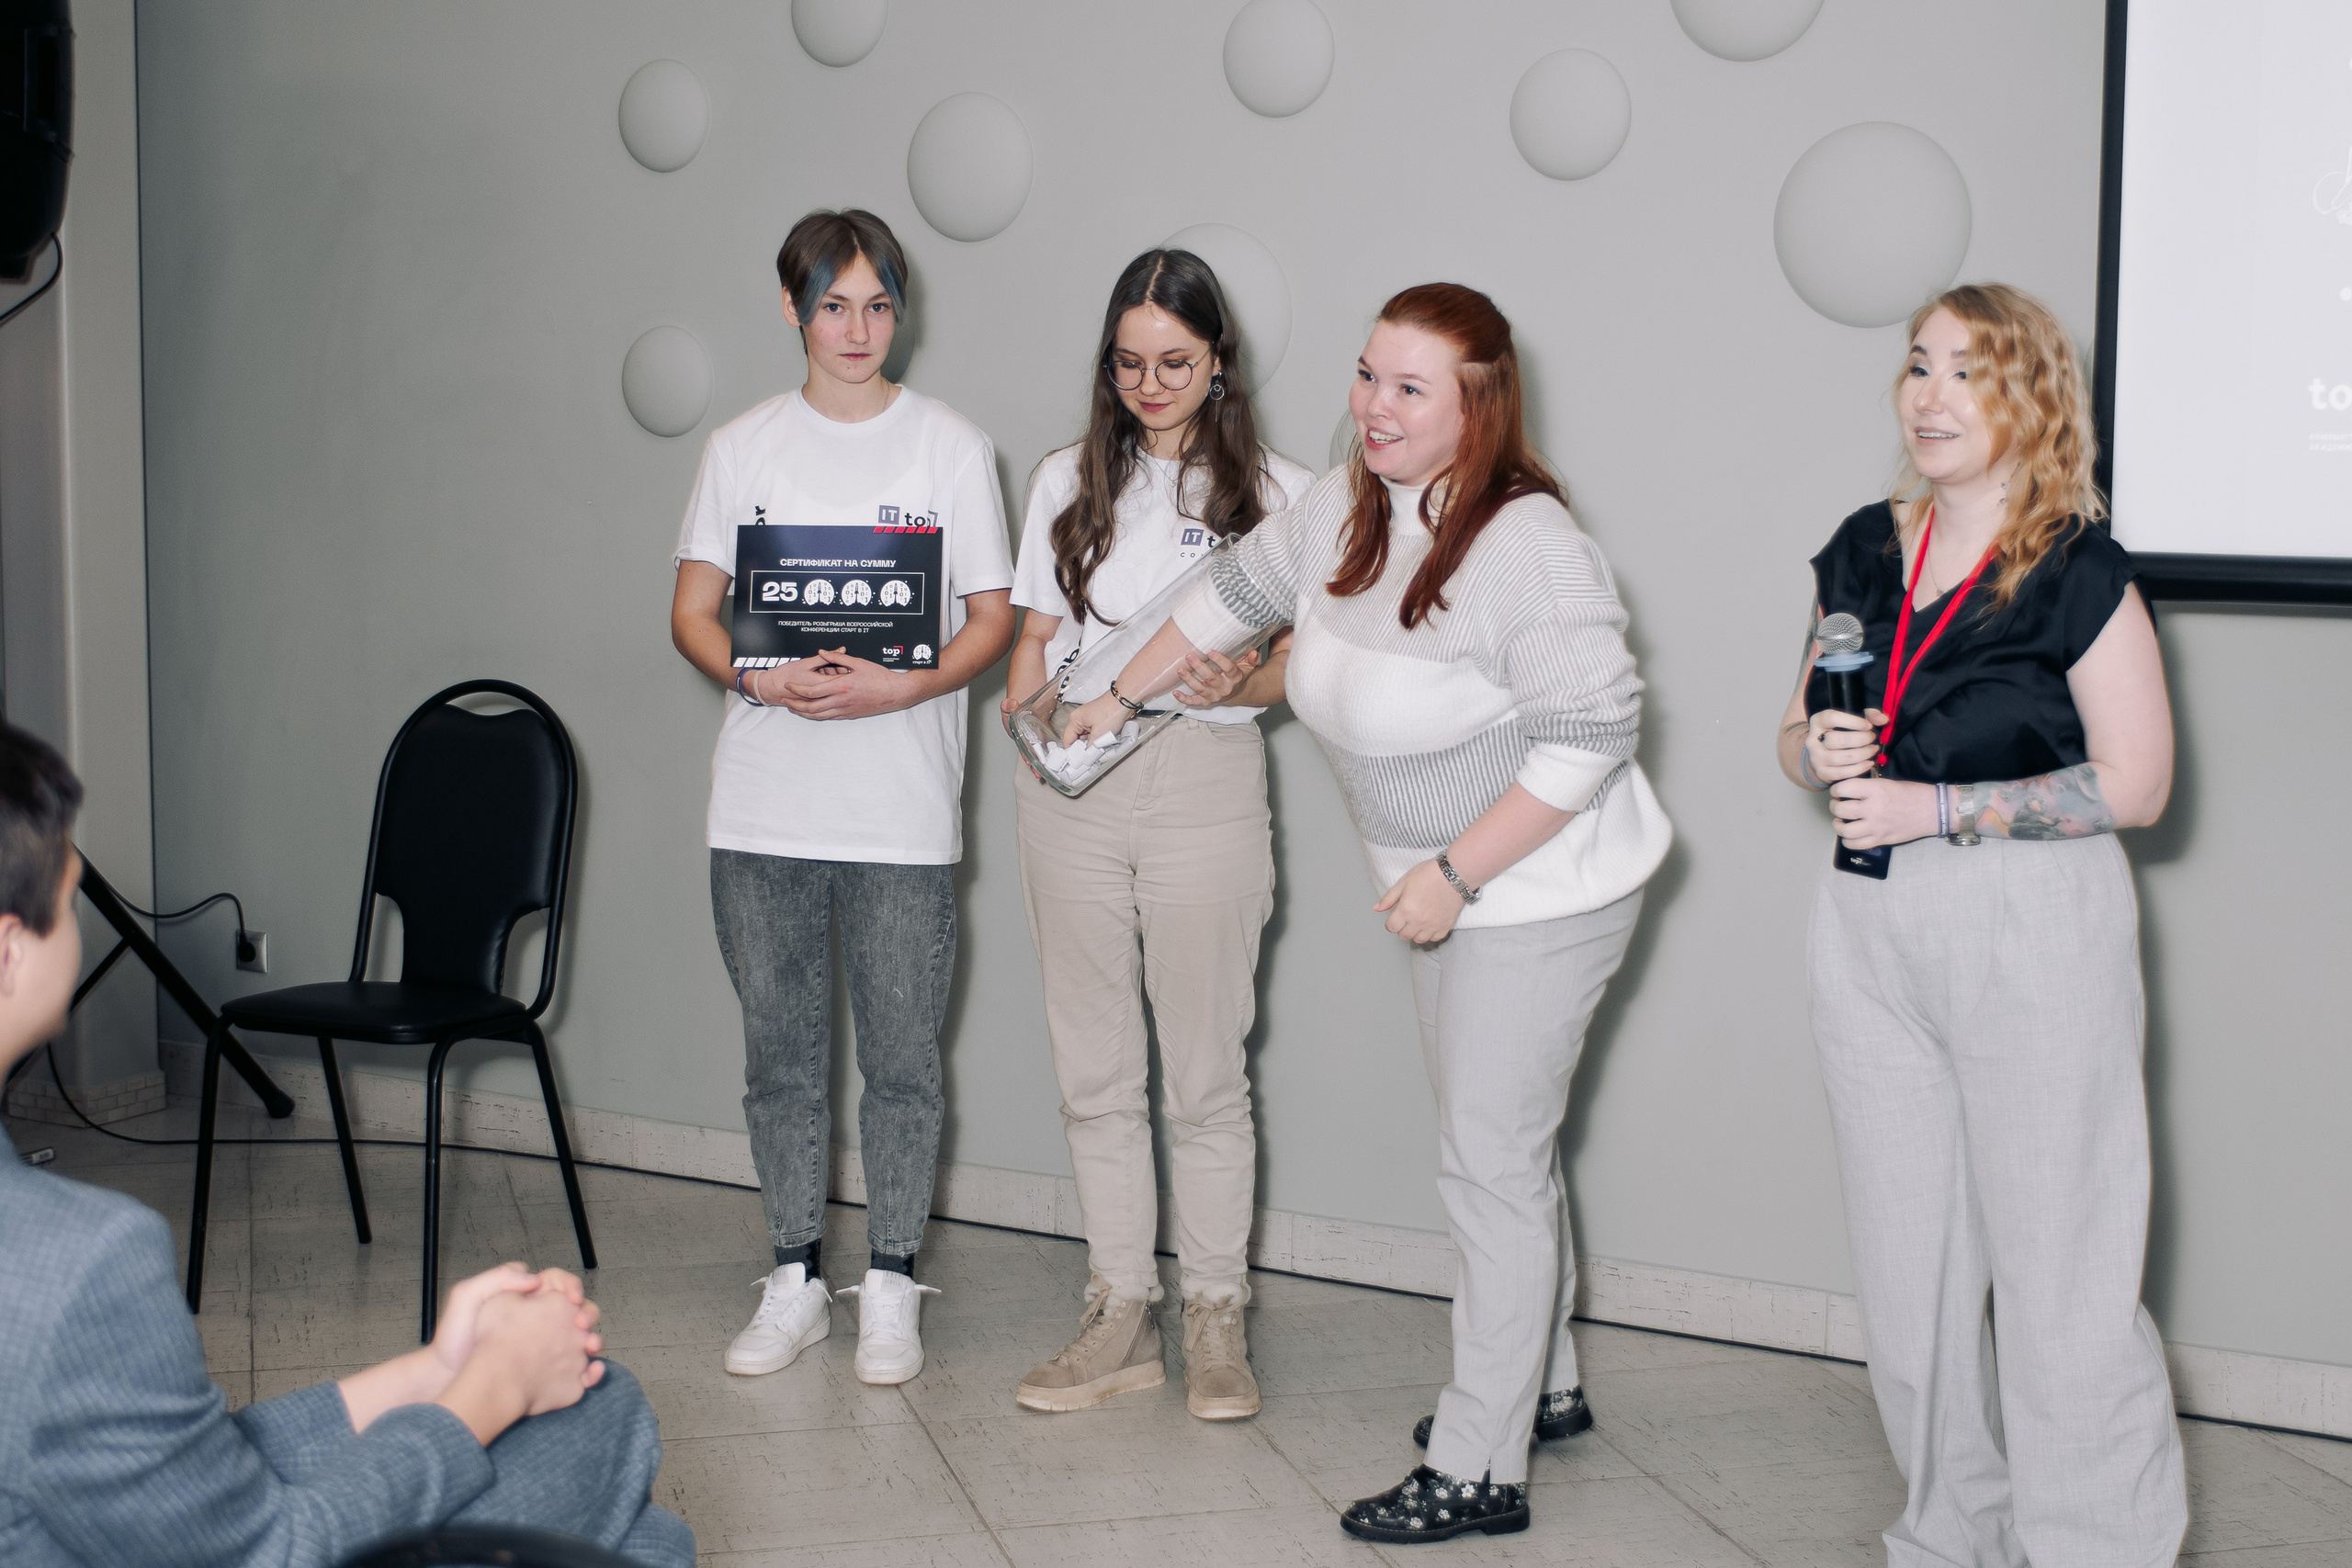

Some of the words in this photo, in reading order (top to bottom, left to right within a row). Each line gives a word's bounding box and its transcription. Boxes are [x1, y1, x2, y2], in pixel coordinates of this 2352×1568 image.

[881, 508, 898, 522] IT
[1183, 531, 1201, 543] IT
[780, 558, 842, 568] СЕРТИФИКАТ
[844, 559, 858, 568] НА
[860, 559, 897, 568] СУММУ
[762, 581, 798, 602] 25
[882, 647, 900, 657] top
